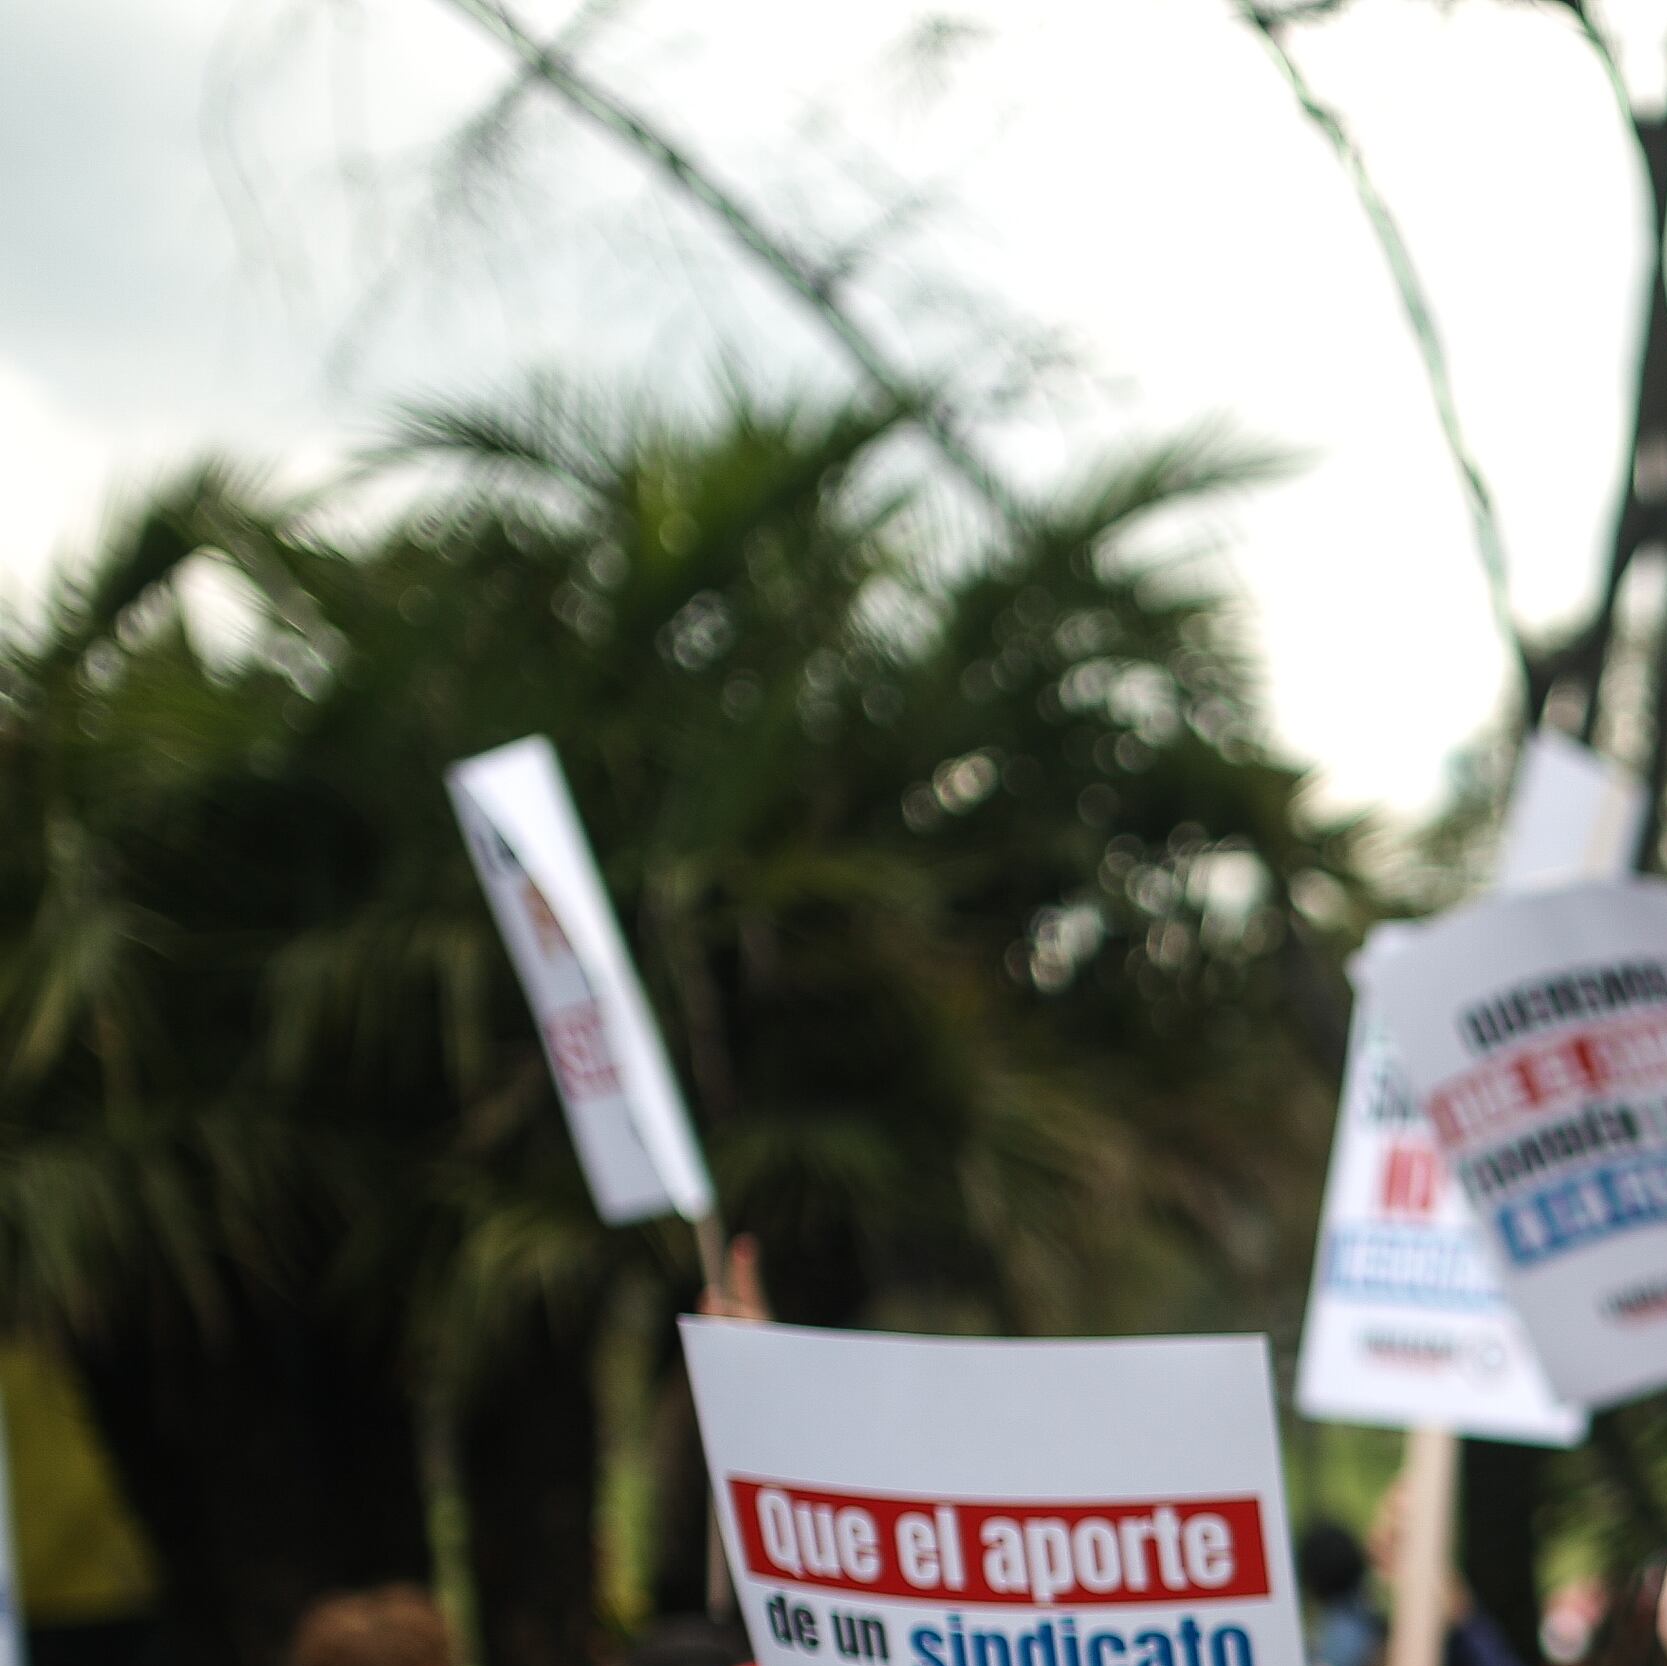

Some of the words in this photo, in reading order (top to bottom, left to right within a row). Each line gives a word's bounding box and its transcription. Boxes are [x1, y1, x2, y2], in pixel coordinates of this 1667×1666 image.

[760, 1488, 880, 1578] Que
[896, 1506, 962, 1590] el
[982, 1508, 1231, 1603] aporte
[768, 1601, 819, 1651] de
[834, 1612, 889, 1660] un
